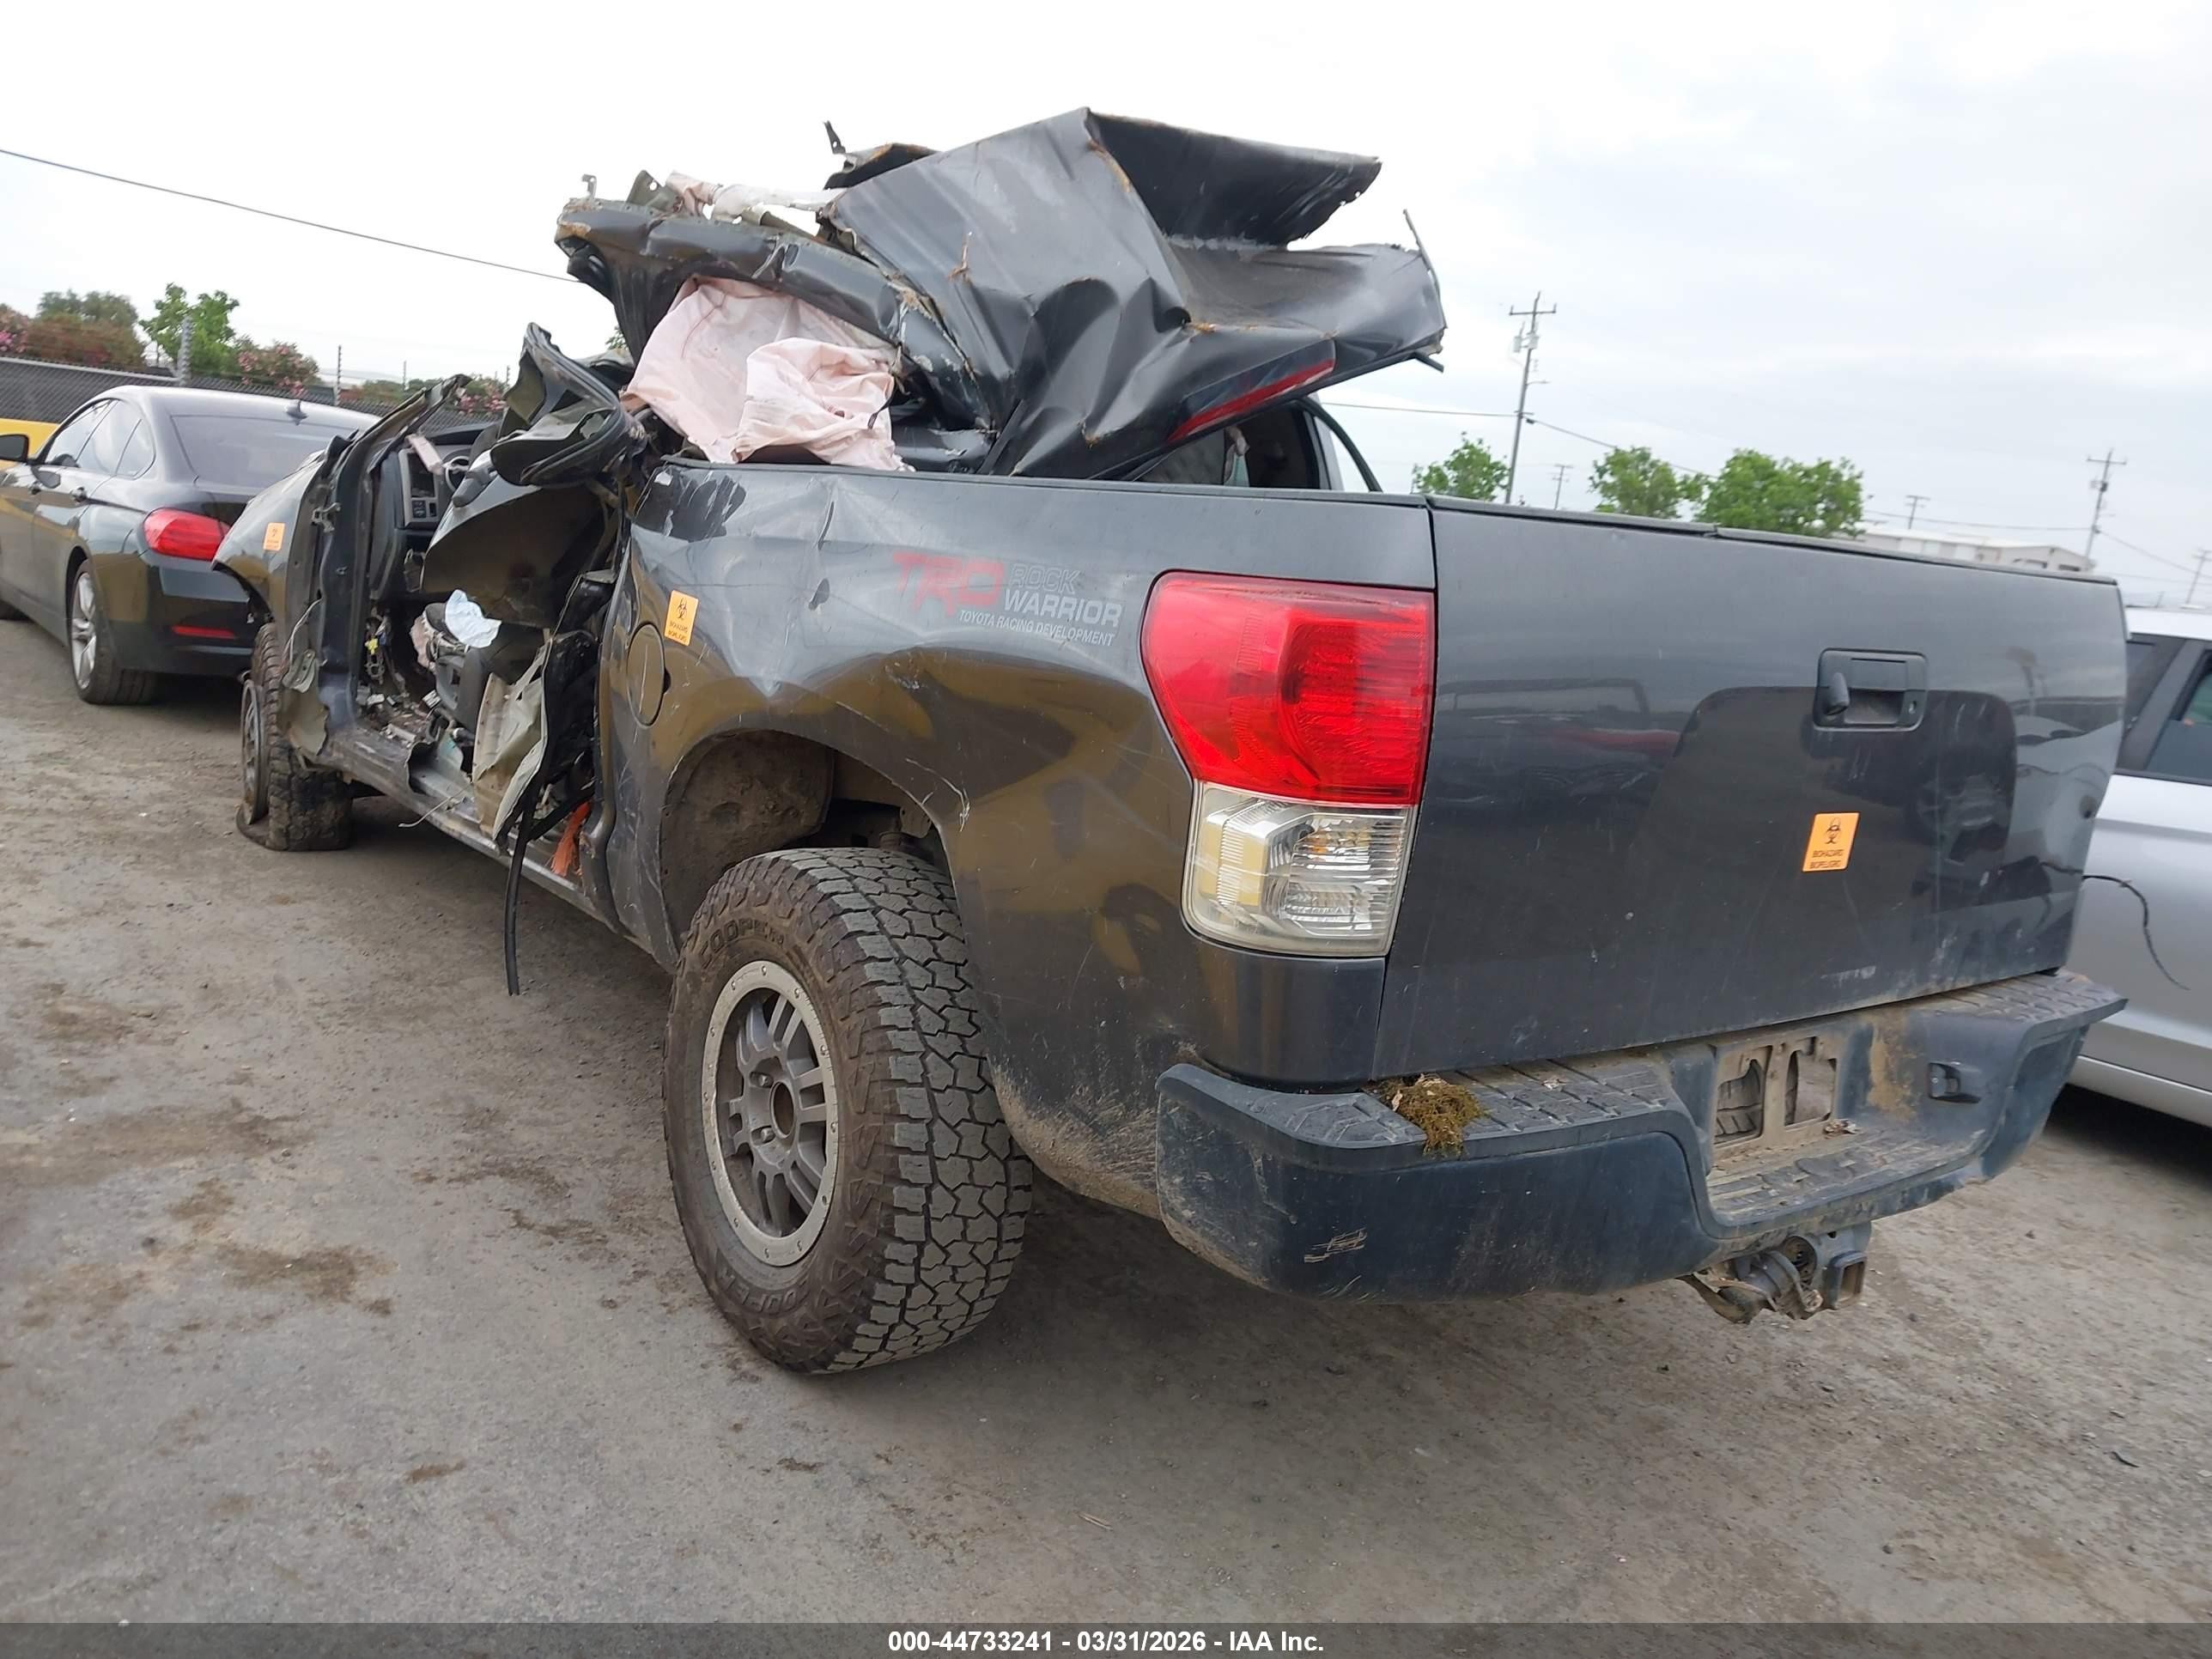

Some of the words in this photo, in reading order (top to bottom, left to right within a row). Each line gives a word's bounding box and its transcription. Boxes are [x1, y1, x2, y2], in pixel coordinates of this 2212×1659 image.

[893, 551, 1005, 617] TRD
[1008, 562, 1080, 594] ROCK
[1003, 588, 1122, 628] WARRIOR
[958, 610, 995, 627] TOYOTA
[996, 615, 1032, 634] RACING
[1036, 621, 1115, 647] DEVELOPMENT
